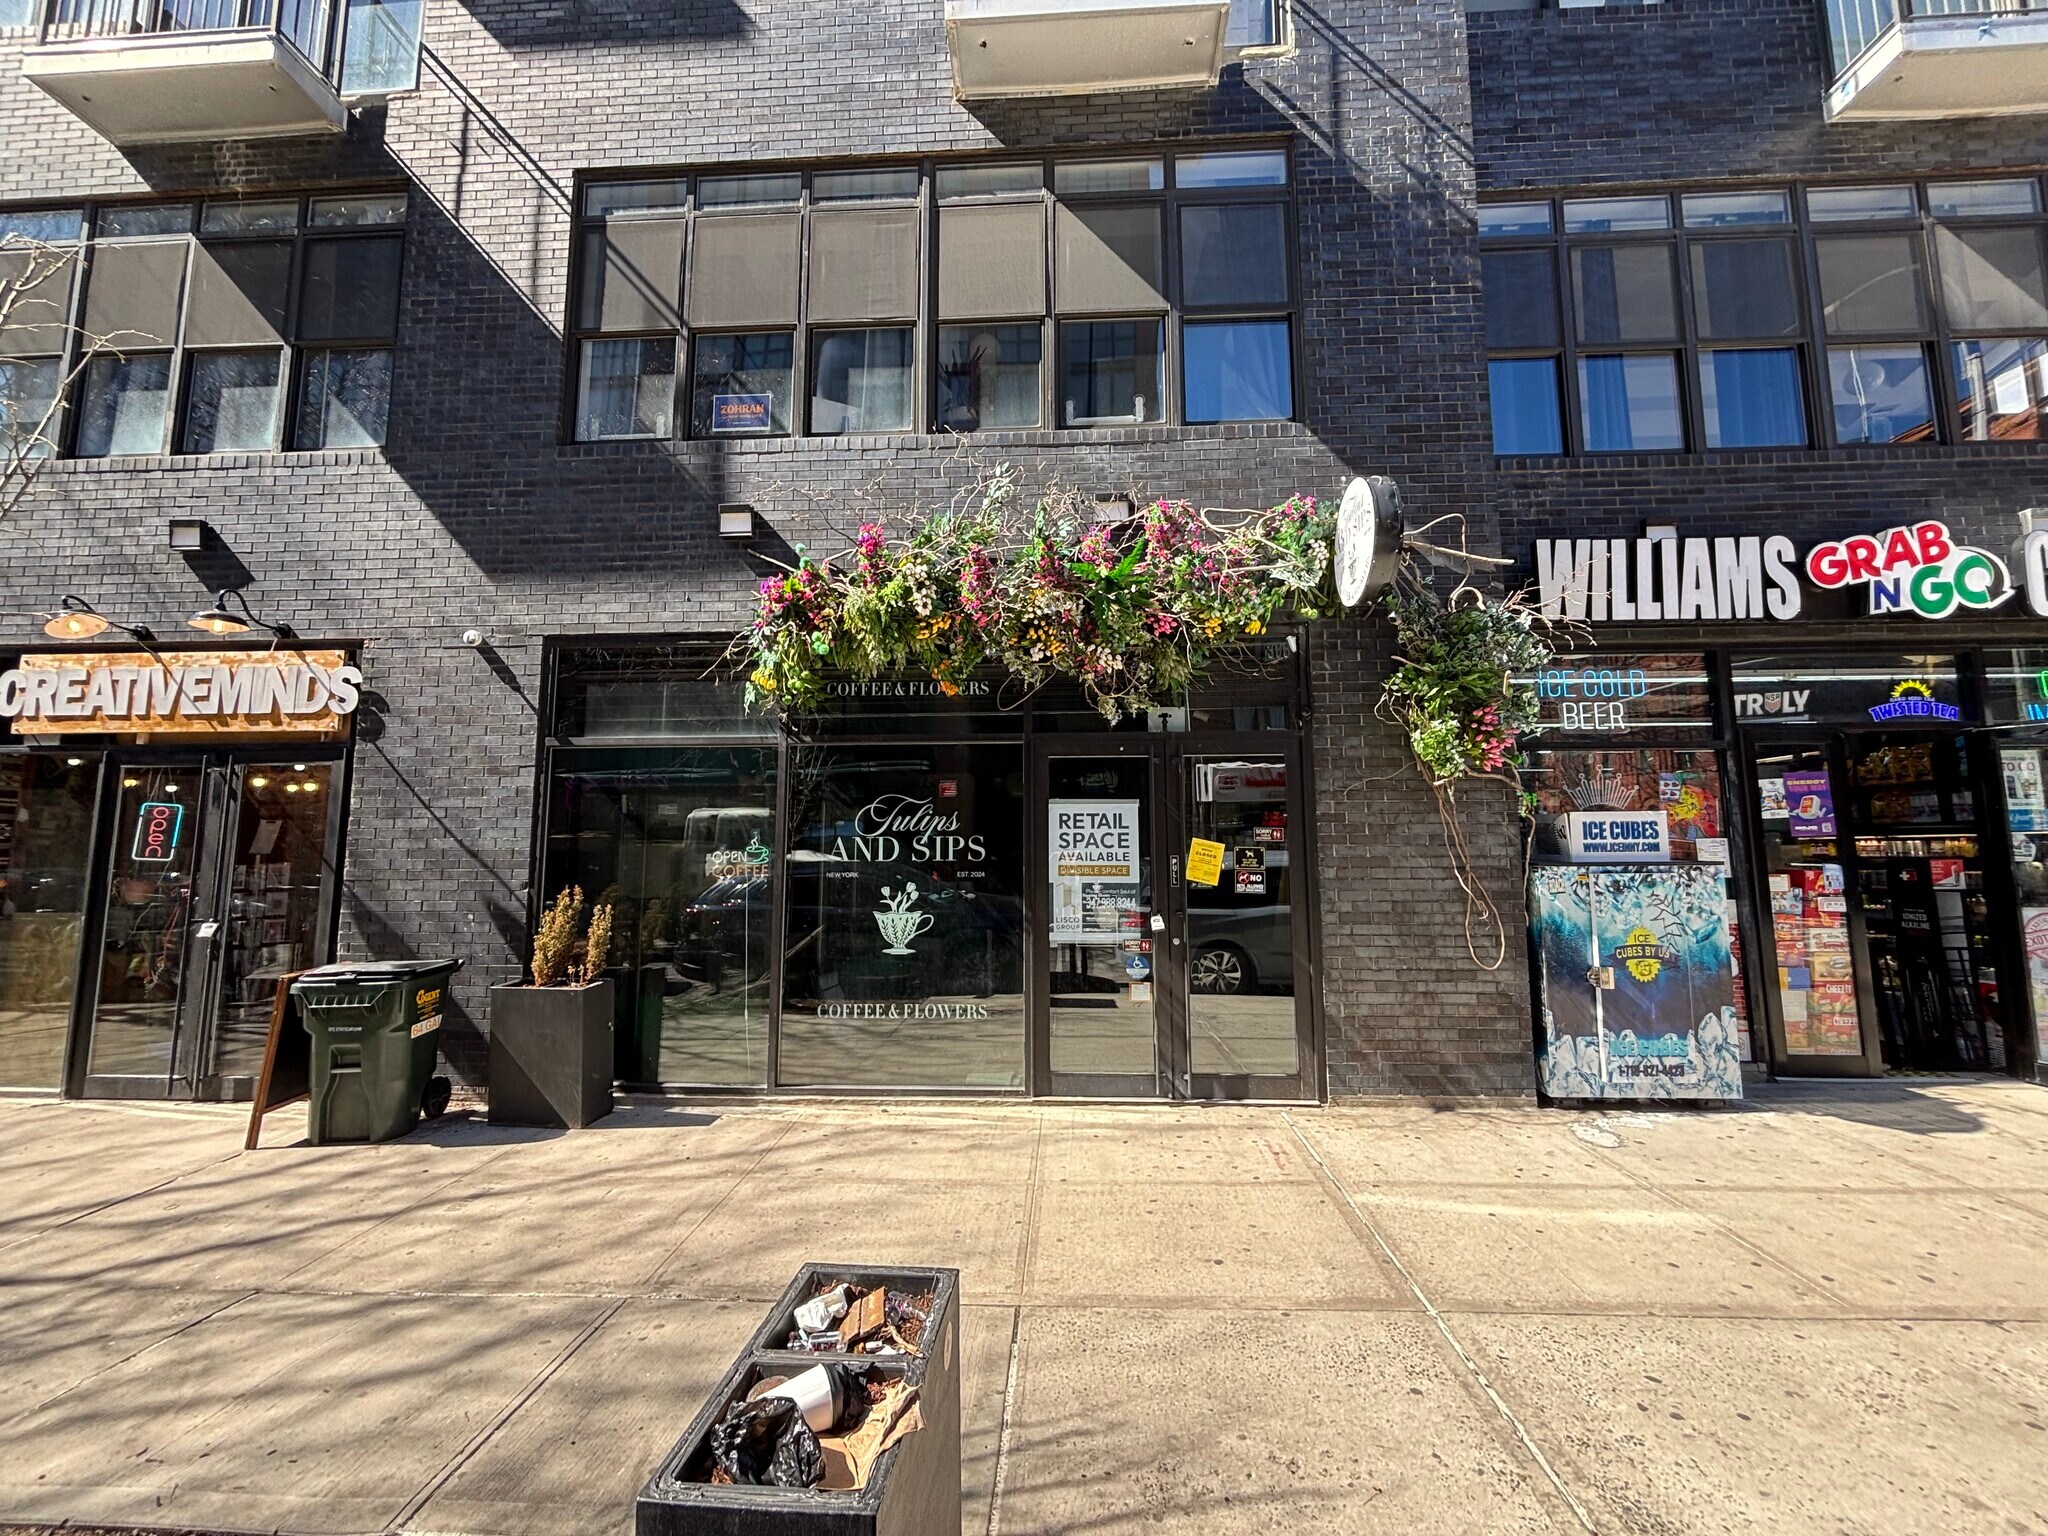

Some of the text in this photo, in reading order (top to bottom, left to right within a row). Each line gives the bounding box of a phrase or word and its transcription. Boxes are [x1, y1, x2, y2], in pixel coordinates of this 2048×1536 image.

[720, 404, 764, 414] ZOHRAN
[1809, 522, 1950, 587] GRAB
[1536, 536, 1801, 621] WILLIAMS
[1873, 578, 1901, 612] N
[1909, 554, 1997, 616] GO
[827, 681, 989, 697] COFFEE & FLOERS
[1539, 670, 1646, 697] ICE COLD
[1562, 702, 1625, 730] BEER
[1869, 701, 1959, 722] TWISTED TEA
[854, 794, 961, 845] Tulips
[1058, 813, 1130, 830] RETAIL
[1582, 820, 1660, 840] ICE CUBES
[1058, 832, 1130, 849] SPACE
[712, 850, 747, 863] OPEN
[831, 836, 986, 862] AND SIPS
[1058, 852, 1130, 862] AVAILABLE
[1195, 851, 1217, 859] CLOSED
[711, 864, 769, 878] COFFEE
[1060, 866, 1128, 875] DIVISIBLE SPACE
[1250, 874, 1262, 882] NO
[1901, 921, 1930, 929] ALKALINE
[1633, 934, 1651, 943] ICE
[1616, 946, 1670, 959] CUBES BY US
[817, 1003, 988, 1019] COFFEE & FLOWERS
[412, 1023, 423, 1036] 64
[1610, 1039, 1688, 1057] ICE CUBES
